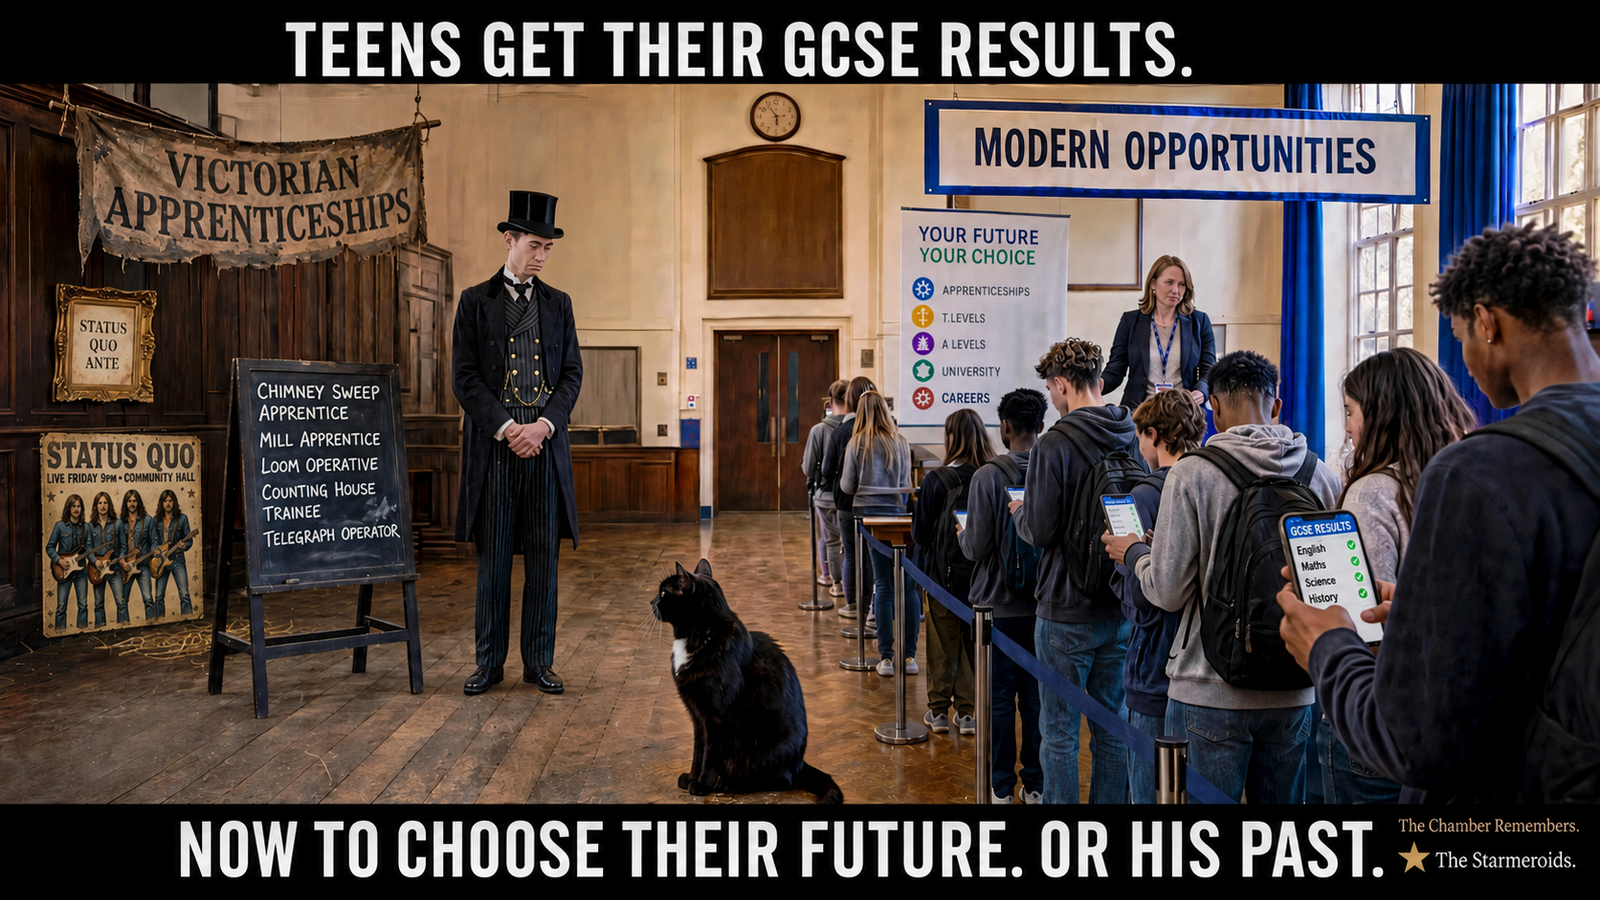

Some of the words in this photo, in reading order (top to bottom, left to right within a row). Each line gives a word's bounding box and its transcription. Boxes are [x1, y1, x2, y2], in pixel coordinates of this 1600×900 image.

[974, 126, 1110, 170] MODERN
[1124, 130, 1378, 176] OPPORTUNITIES
[165, 150, 360, 197] VICTORIAN
[104, 187, 411, 243] APPRENTICESHIPS
[918, 226, 967, 243] YOUR
[973, 228, 1039, 245] FUTURE
[919, 247, 967, 264] YOUR
[971, 249, 1036, 265] CHOICE
[942, 285, 1031, 297] APPRENTICESHIPS
[80, 319, 128, 335] STATUS
[89, 338, 118, 354] QUO
[941, 339, 949, 350] A
[952, 339, 986, 350] LEVELS
[85, 356, 120, 370] ANTE
[942, 366, 1001, 377] UNIVERSITY
[257, 382, 325, 400] CHIMNEY
[332, 384, 380, 401] SWEEP
[941, 392, 990, 404] CAREERS
[258, 404, 349, 422] APPRENTICE
[259, 432, 294, 448] MILL
[299, 431, 381, 448] APPRENTICE
[47, 441, 138, 469] STATUS
[146, 442, 195, 472] QUO
[261, 457, 300, 475] LOOM
[305, 457, 379, 473] OPERATIVE
[47, 473, 65, 484] LIVE
[68, 473, 98, 484] FRIDAY
[124, 472, 173, 483] COMMUNITY
[176, 472, 196, 482] HALL
[261, 483, 328, 500] COUNTING
[334, 481, 376, 497] HOUSE
[262, 504, 321, 522] TRAINEE
[263, 528, 336, 548] TELEGRAPH
[341, 523, 400, 541] OPERATOR
[1290, 525, 1314, 536] GCSE
[1314, 521, 1352, 534] RESULTS
[1296, 543, 1326, 557] English
[1301, 561, 1327, 571] Maths
[1305, 577, 1336, 588] Science
[1308, 593, 1338, 604] History
